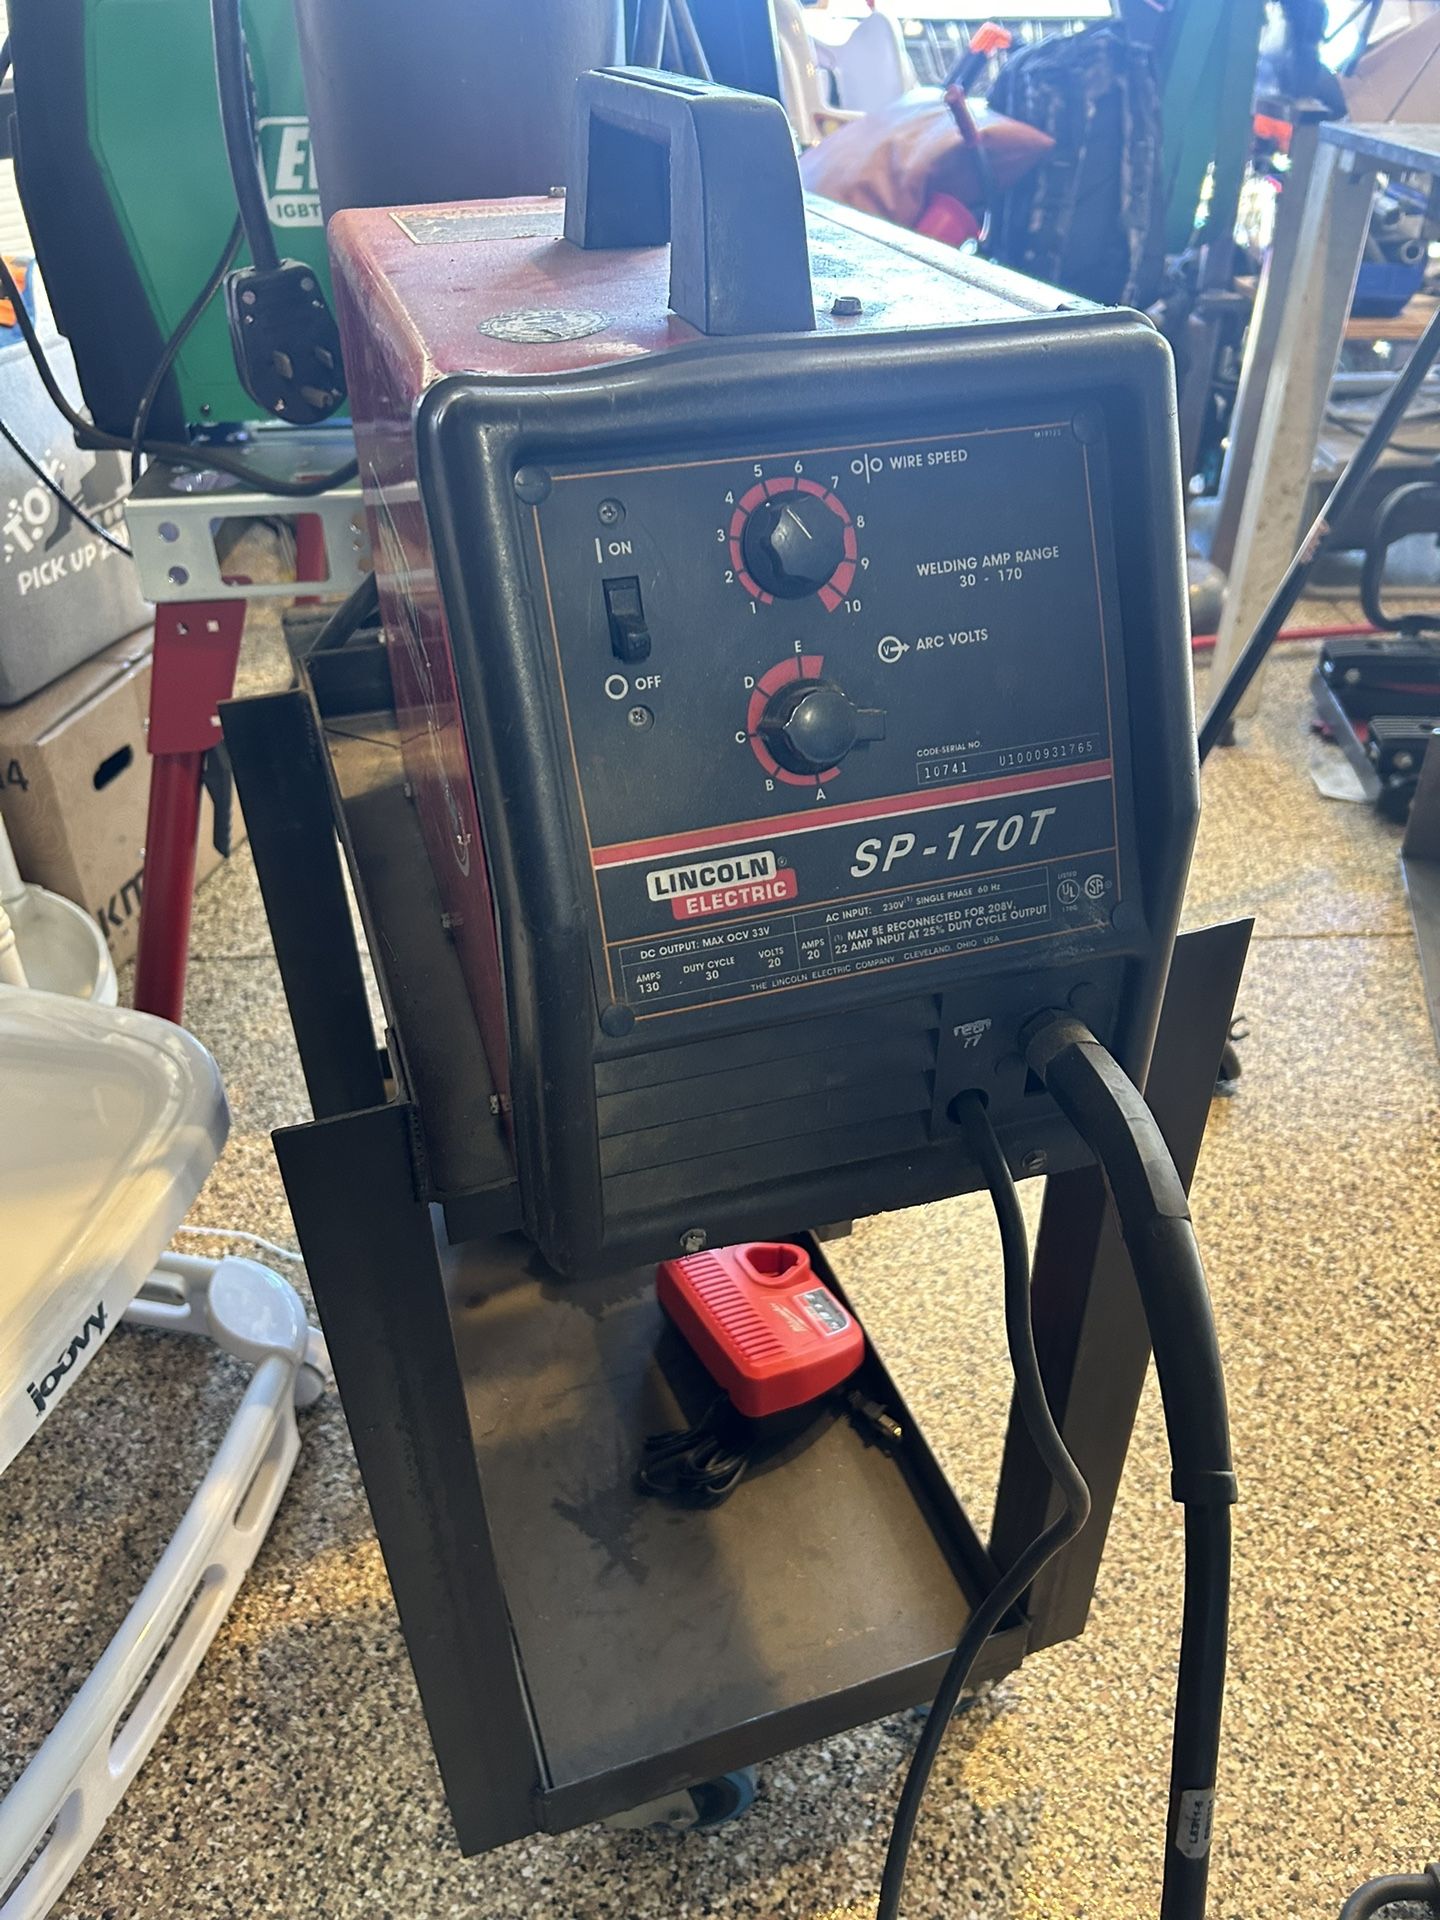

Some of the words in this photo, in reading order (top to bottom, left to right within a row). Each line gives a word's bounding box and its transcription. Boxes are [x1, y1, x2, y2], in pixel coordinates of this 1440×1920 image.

[277, 203, 320, 218] IGBT
[889, 455, 923, 469] WIRE
[928, 449, 967, 464] SPEED
[754, 465, 763, 477] 5
[794, 461, 803, 473] 6
[831, 476, 839, 489] 7
[725, 491, 735, 504] 4
[856, 515, 865, 528] 8
[717, 530, 726, 542] 3
[609, 541, 632, 555] ON
[861, 558, 870, 571] 9
[916, 556, 978, 576] WELDING
[982, 552, 1011, 568] AMP
[1015, 546, 1060, 563] RANGE
[17, 555, 68, 595] PICK
[70, 543, 97, 572] UP
[725, 571, 734, 583] 2
[959, 574, 976, 588] 30
[997, 567, 1023, 582] 170
[750, 602, 757, 614] 1
[845, 600, 861, 613] 10
[794, 640, 802, 653] E
[916, 638, 944, 651] ARC
[949, 629, 989, 646] VOLTS
[635, 676, 662, 690] OFF
[744, 676, 755, 689] D
[735, 731, 746, 744] C
[916, 744, 966, 757] CODE-SERIAL
[924, 761, 967, 779] 10741
[999, 740, 1093, 767] U1000931765
[765, 779, 774, 791] B
[816, 788, 826, 800] A
[850, 807, 1057, 878] SP-170T
[654, 857, 769, 896] LINCOLN
[686, 881, 787, 915] ELECTRIC
[825, 912, 840, 923] AC
[842, 906, 872, 919] INPUT:
[916, 892, 945, 905] SINGLE
[947, 887, 973, 899] PHASE
[978, 884, 989, 894] 60
[990, 883, 1001, 891] Hz
[835, 943, 849, 954] 22
[850, 938, 874, 951] AMP
[876, 932, 906, 946] INPUT
[907, 929, 920, 940] AT
[923, 925, 945, 937] 25%
[948, 919, 973, 932] DUTY
[975, 912, 1008, 927] CYCLE
[1010, 904, 1048, 920] OUTPUT
[847, 927, 870, 941] MAY
[872, 924, 885, 936] BE
[887, 910, 961, 933] RECONNECTED
[964, 906, 985, 918] FOR
[640, 949, 656, 960] DC
[659, 940, 700, 956] OUTPUT:
[702, 935, 725, 948] MAX
[727, 930, 750, 943] OCV
[752, 926, 771, 938] 33V
[801, 938, 826, 950] AMPS
[758, 946, 785, 959] VOLTS
[807, 949, 821, 960] 20
[683, 963, 705, 974] DUTY
[707, 956, 736, 969] CYCLE
[751, 982, 768, 992] THE
[772, 973, 808, 987] LINCOLN
[812, 963, 851, 979] ELECTRIC
[855, 955, 895, 970] COMPANY
[956, 939, 978, 950] OHIO
[983, 935, 1000, 945] USA
[768, 957, 782, 968] 20
[636, 971, 662, 984] AMPS
[705, 970, 720, 981] 30
[639, 981, 660, 994] 130
[26, 1300, 106, 1416] joovy
